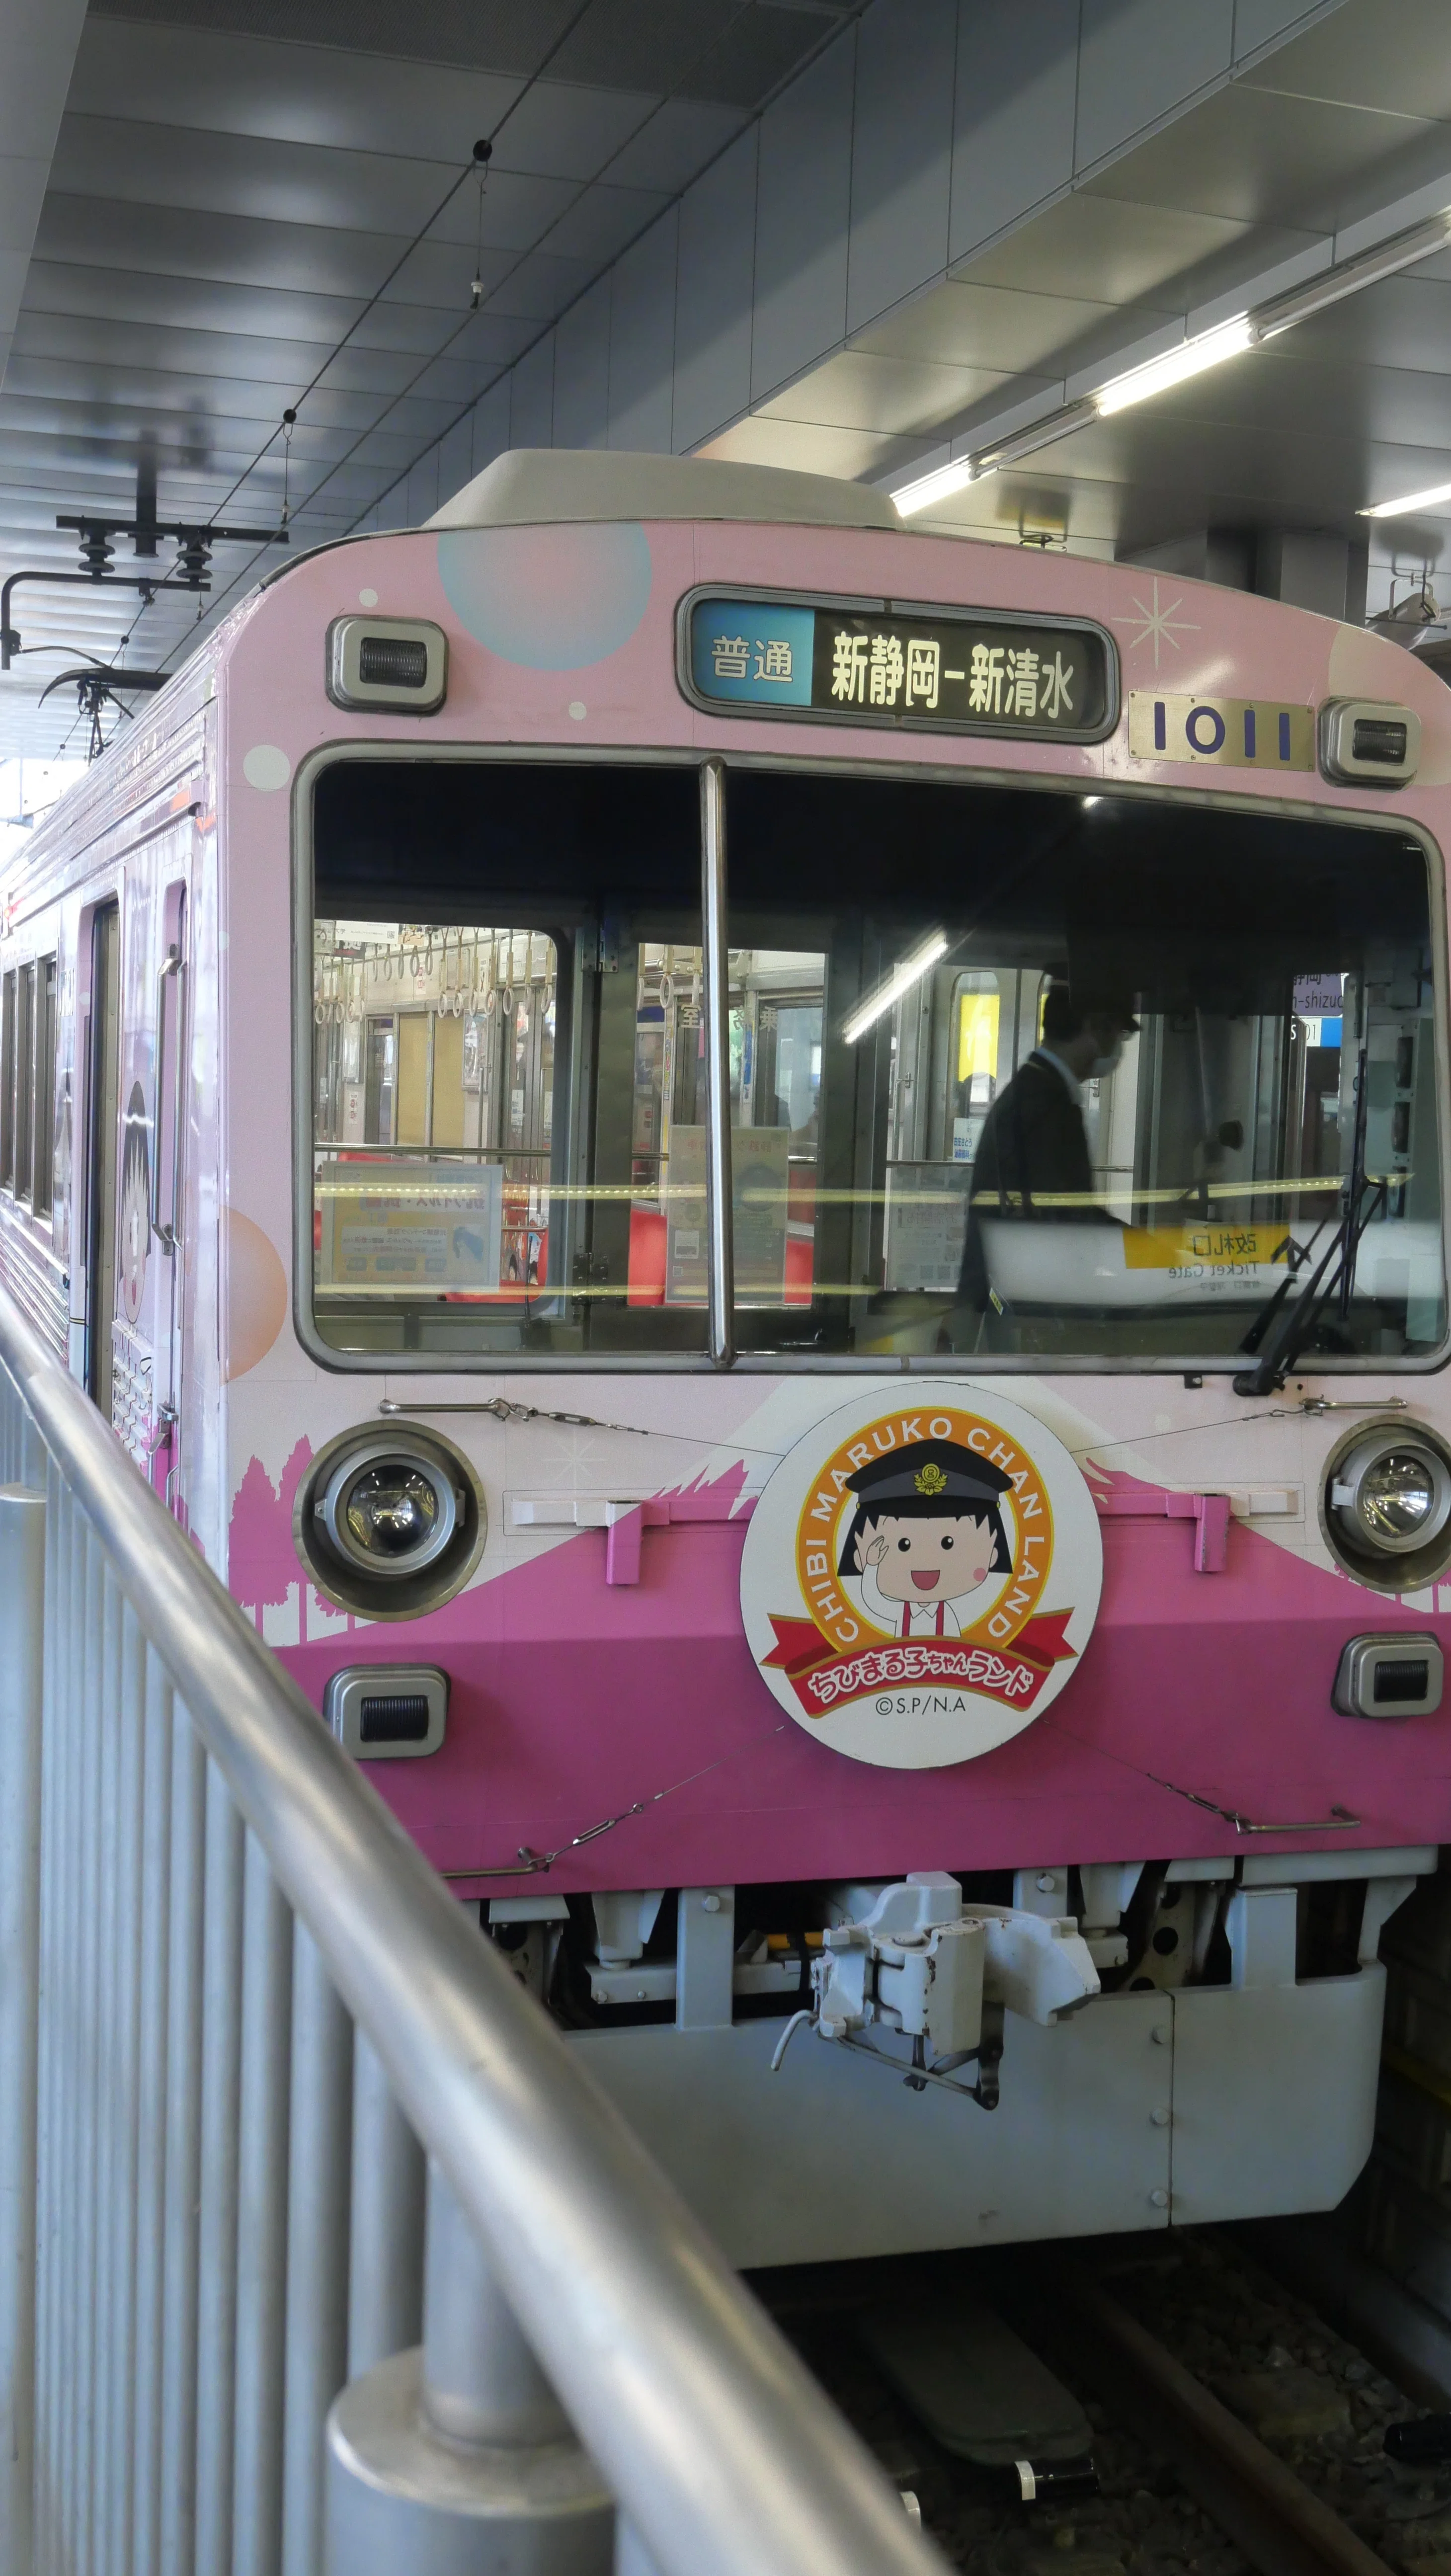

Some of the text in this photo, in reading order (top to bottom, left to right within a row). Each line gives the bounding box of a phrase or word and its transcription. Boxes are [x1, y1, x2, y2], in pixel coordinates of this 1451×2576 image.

[711, 634, 794, 684] 普通
[1153, 701, 1290, 761] 1011
[805, 1416, 1045, 1642] CHIBI MARUKO CHAN LAND
[808, 1646, 1034, 1704] ちびまる子ちゃんランド
